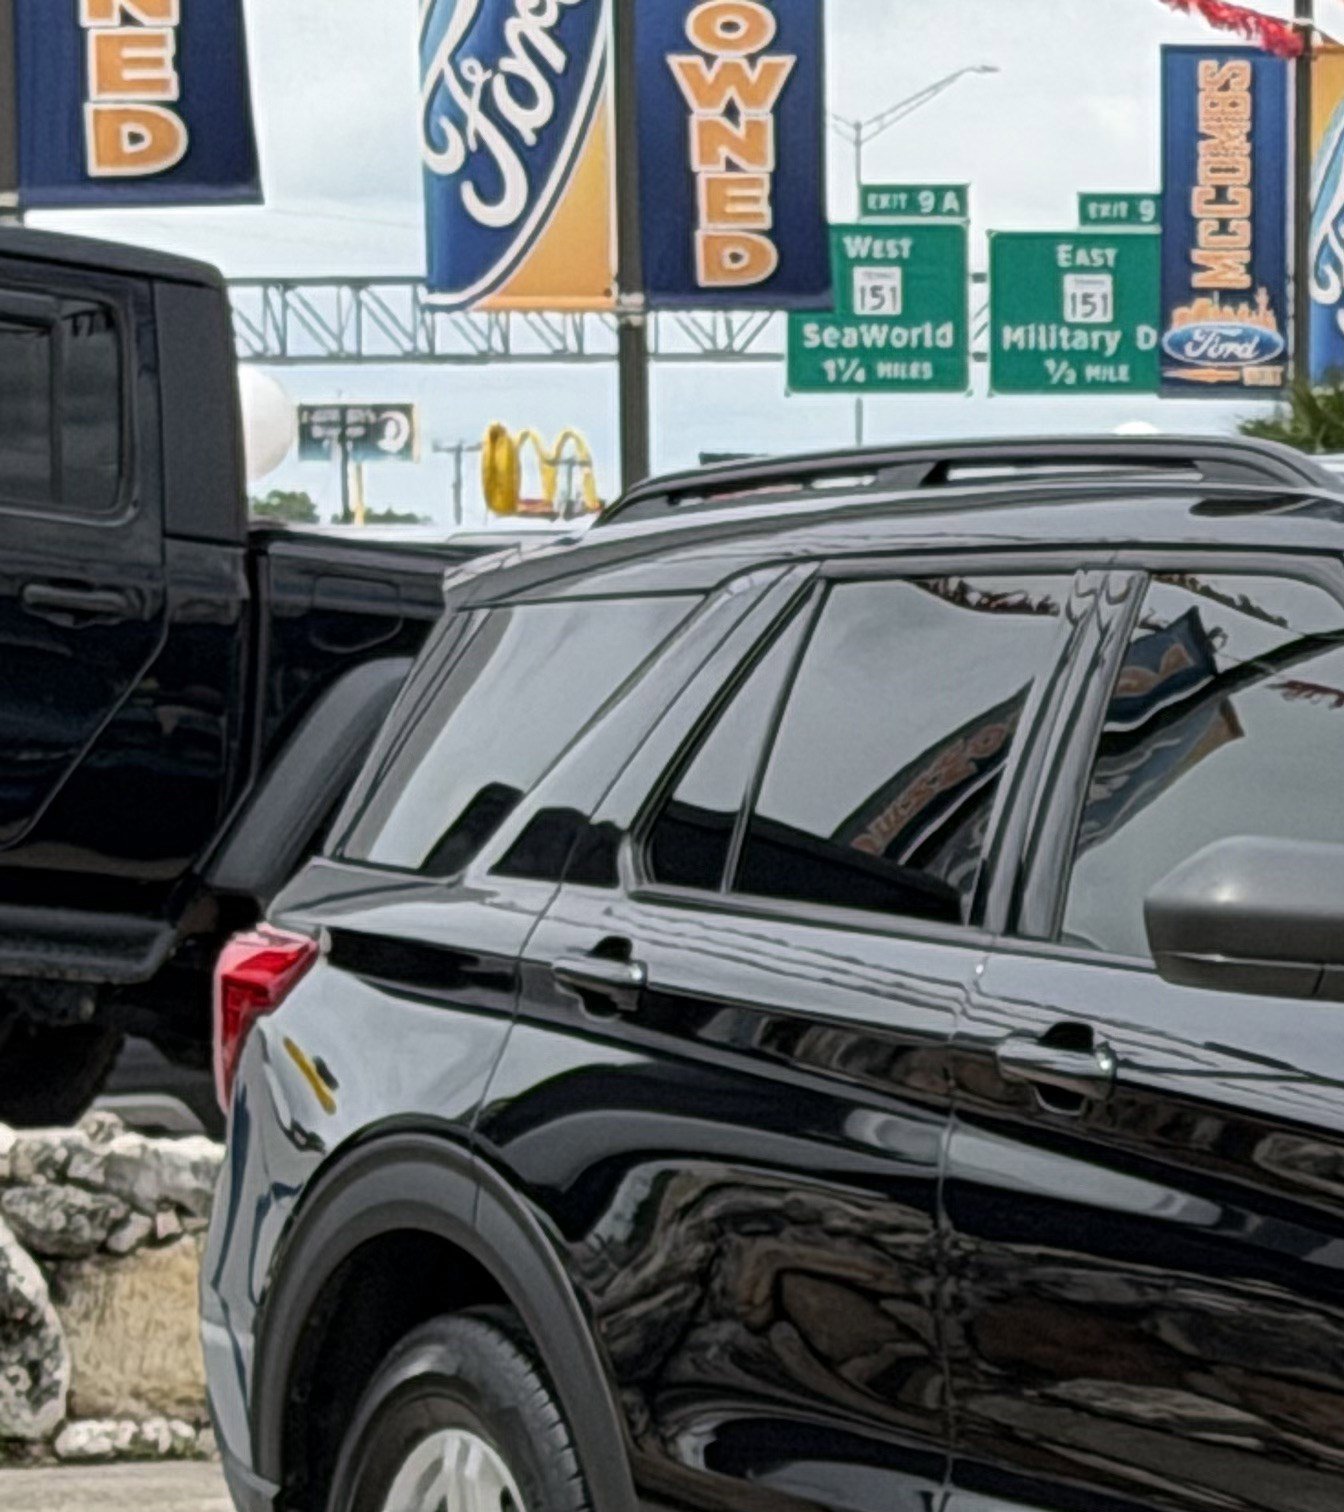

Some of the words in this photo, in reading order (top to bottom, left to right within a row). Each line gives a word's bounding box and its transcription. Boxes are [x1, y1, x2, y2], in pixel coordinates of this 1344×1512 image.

[422, 0, 583, 228] For
[667, 0, 797, 287] OWNED
[867, 193, 907, 210] EXIT
[1088, 202, 1128, 219] EXIT
[1139, 200, 1156, 222] 9
[842, 236, 912, 259] WEST
[1056, 244, 1118, 268] EAST
[859, 285, 898, 312] 151
[1071, 291, 1109, 318] 151
[803, 322, 953, 349] SeaWorld
[1003, 323, 1122, 357] Military
[1136, 325, 1158, 350] D
[1185, 325, 1262, 360] Ford
[876, 361, 933, 380] MILES
[1085, 364, 1130, 383] MILE
